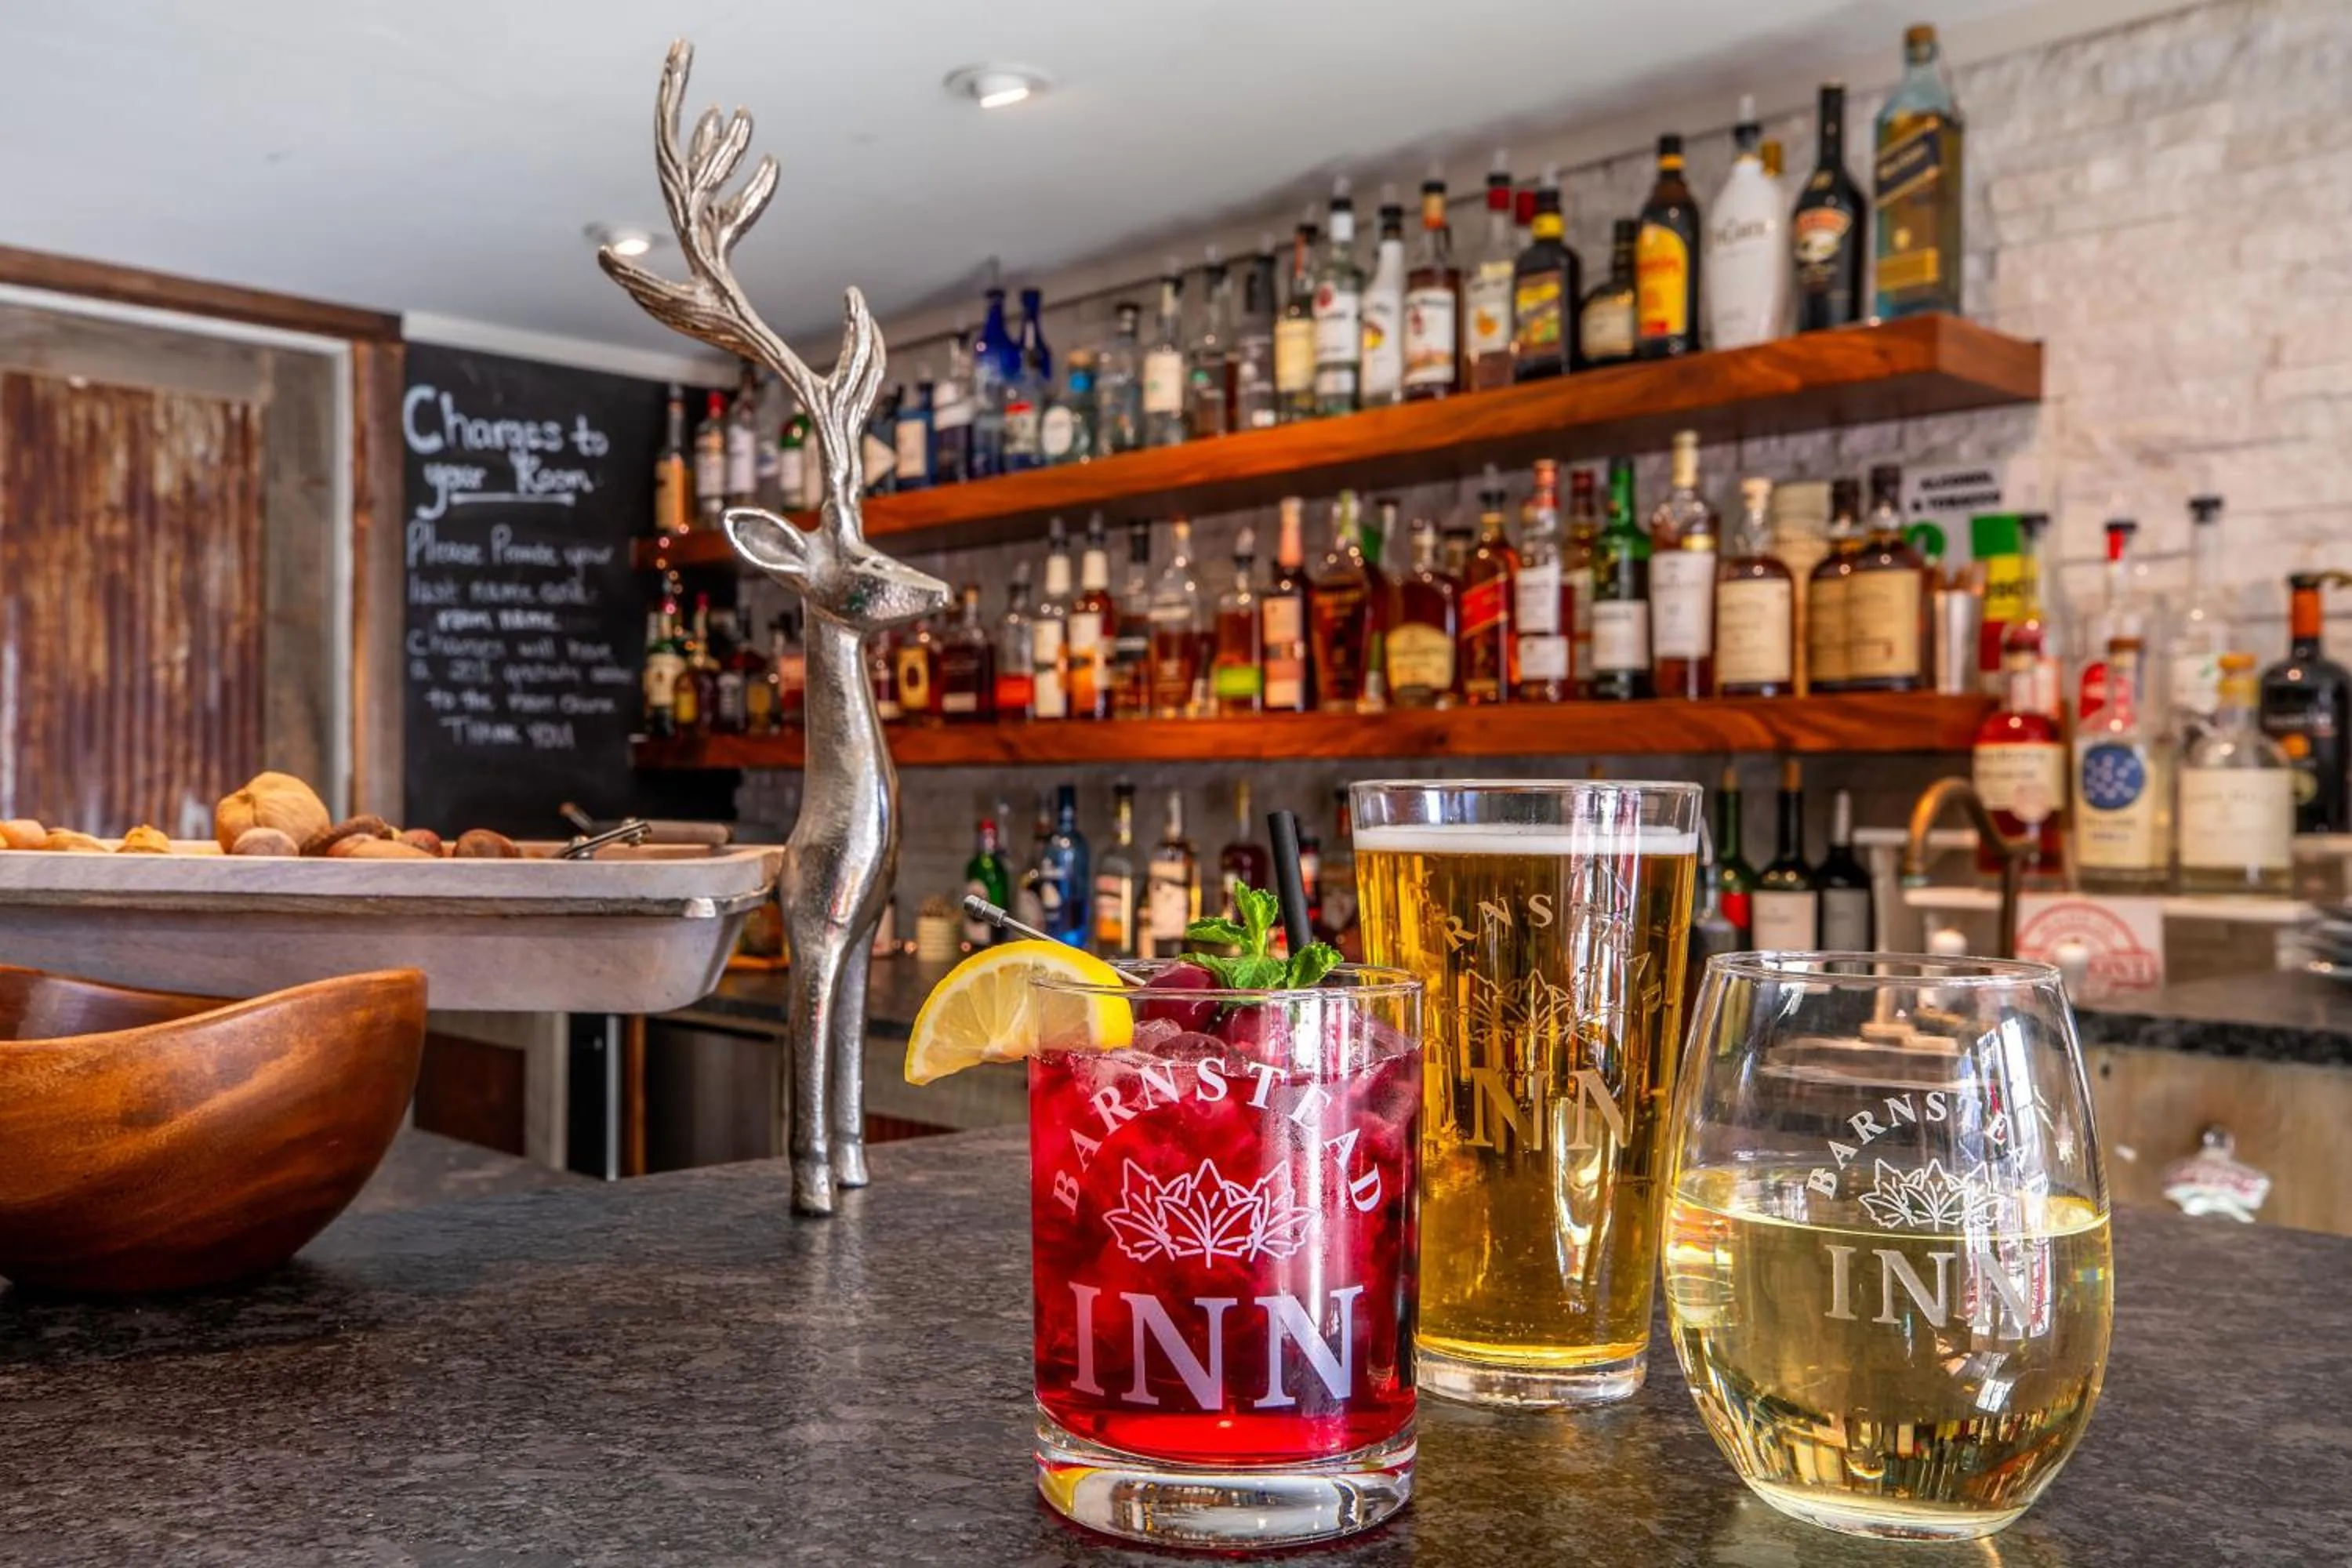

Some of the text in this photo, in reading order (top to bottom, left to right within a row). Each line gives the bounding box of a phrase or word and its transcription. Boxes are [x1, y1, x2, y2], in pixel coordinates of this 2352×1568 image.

[570, 414, 610, 457] to
[416, 463, 488, 521] your
[1052, 1057, 1383, 1217] BARNSTEAD
[1824, 1244, 2037, 1328] INN
[1068, 1280, 1364, 1410] INN
